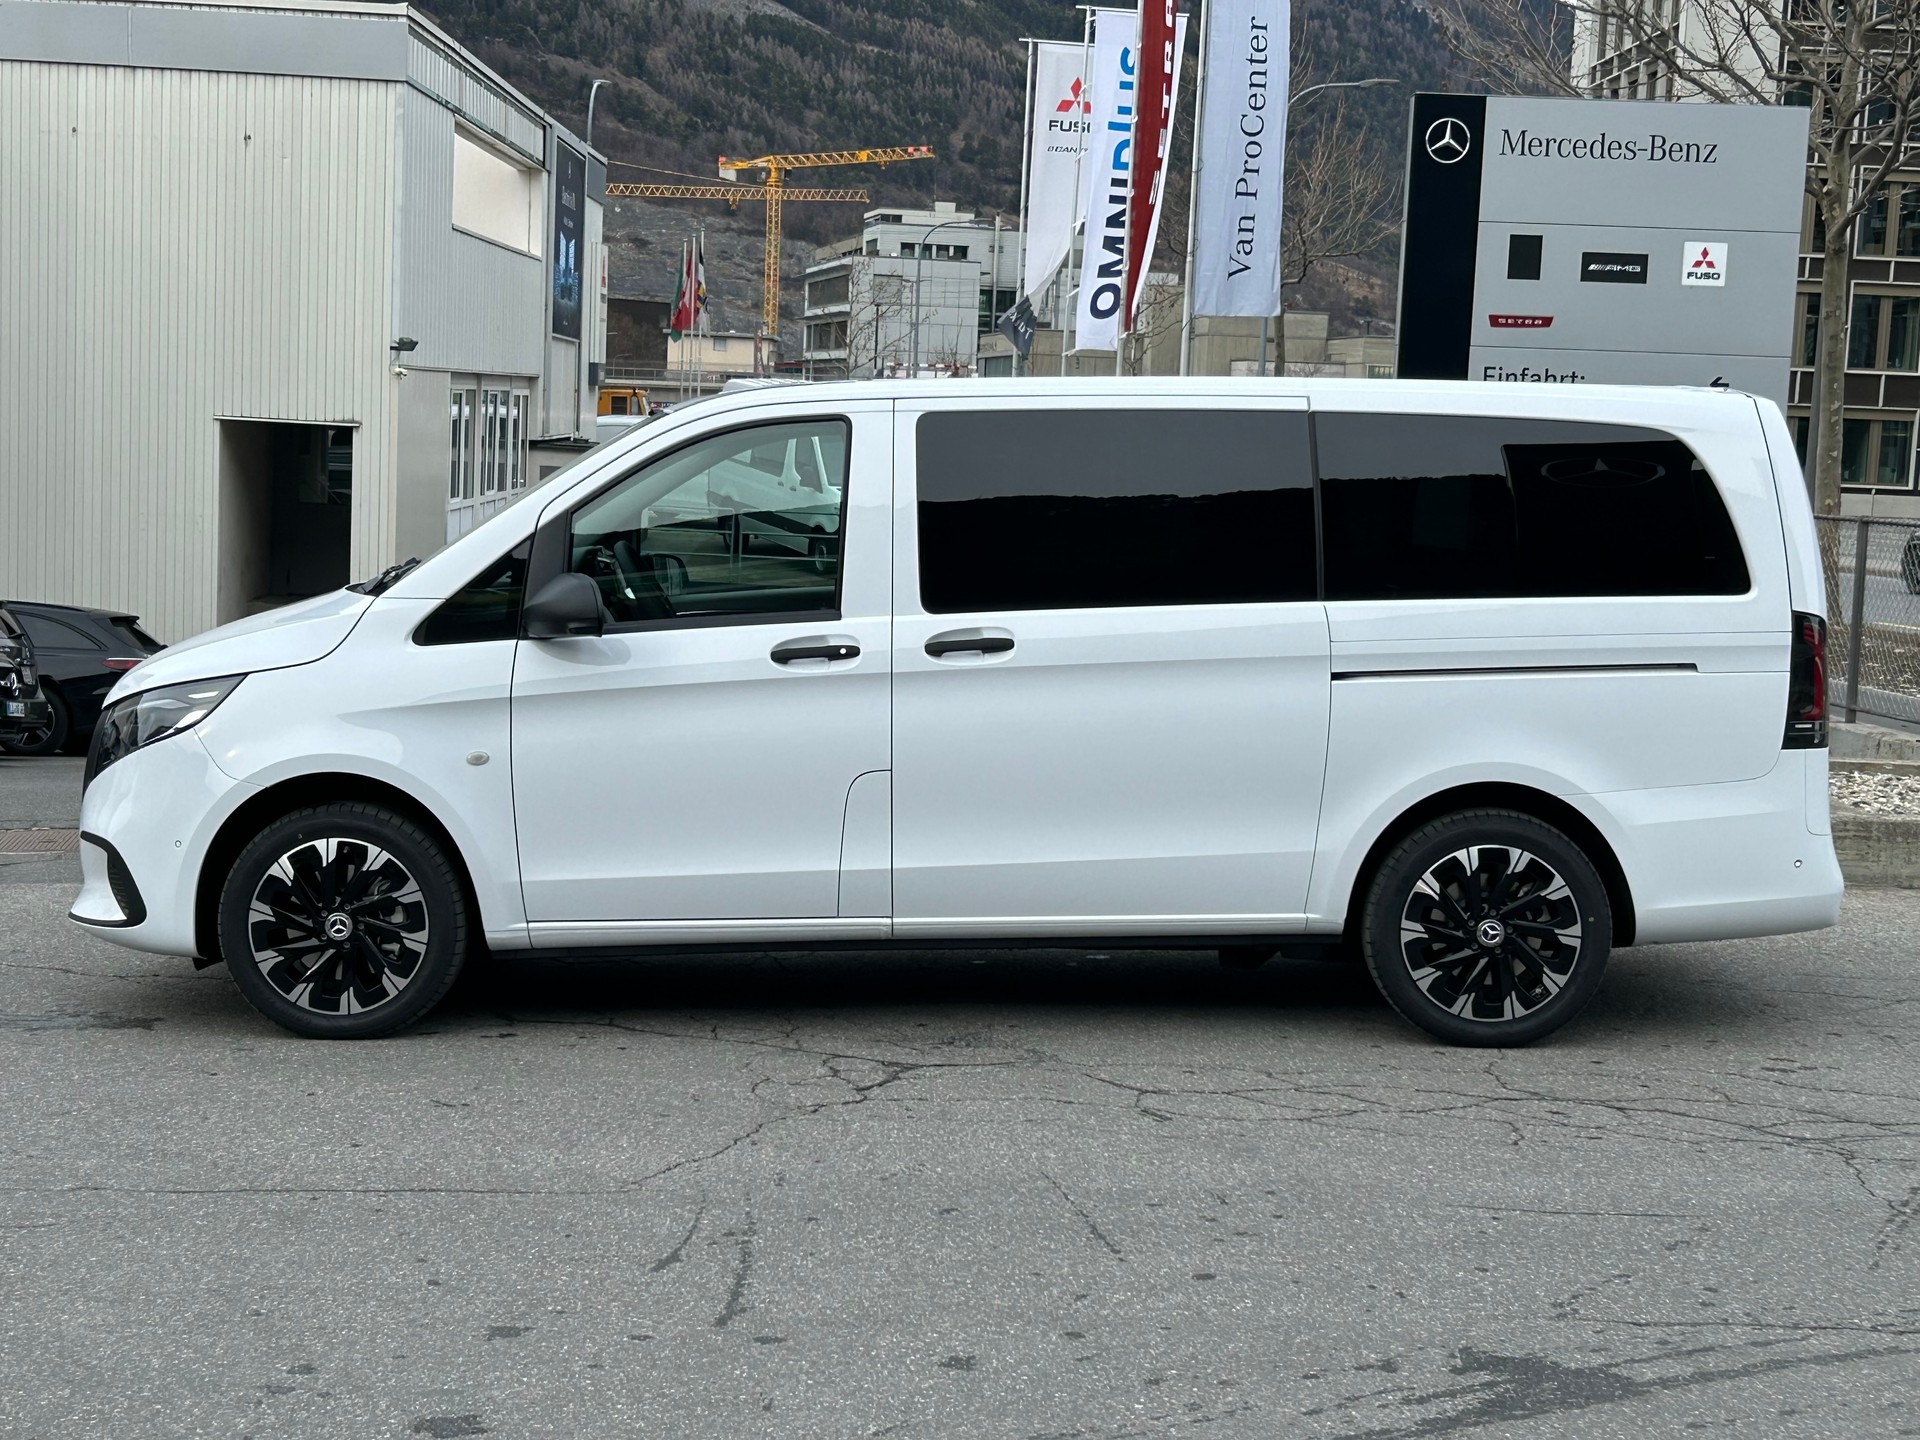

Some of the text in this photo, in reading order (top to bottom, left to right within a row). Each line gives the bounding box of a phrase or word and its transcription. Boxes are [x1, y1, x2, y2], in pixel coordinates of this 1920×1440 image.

[1048, 119, 1091, 133] FUS
[1227, 16, 1268, 281] Van ProCenter
[1499, 128, 1718, 164] Mercedes-Benz
[1686, 271, 1721, 281] FUSO
[1498, 318, 1543, 326] SETRA
